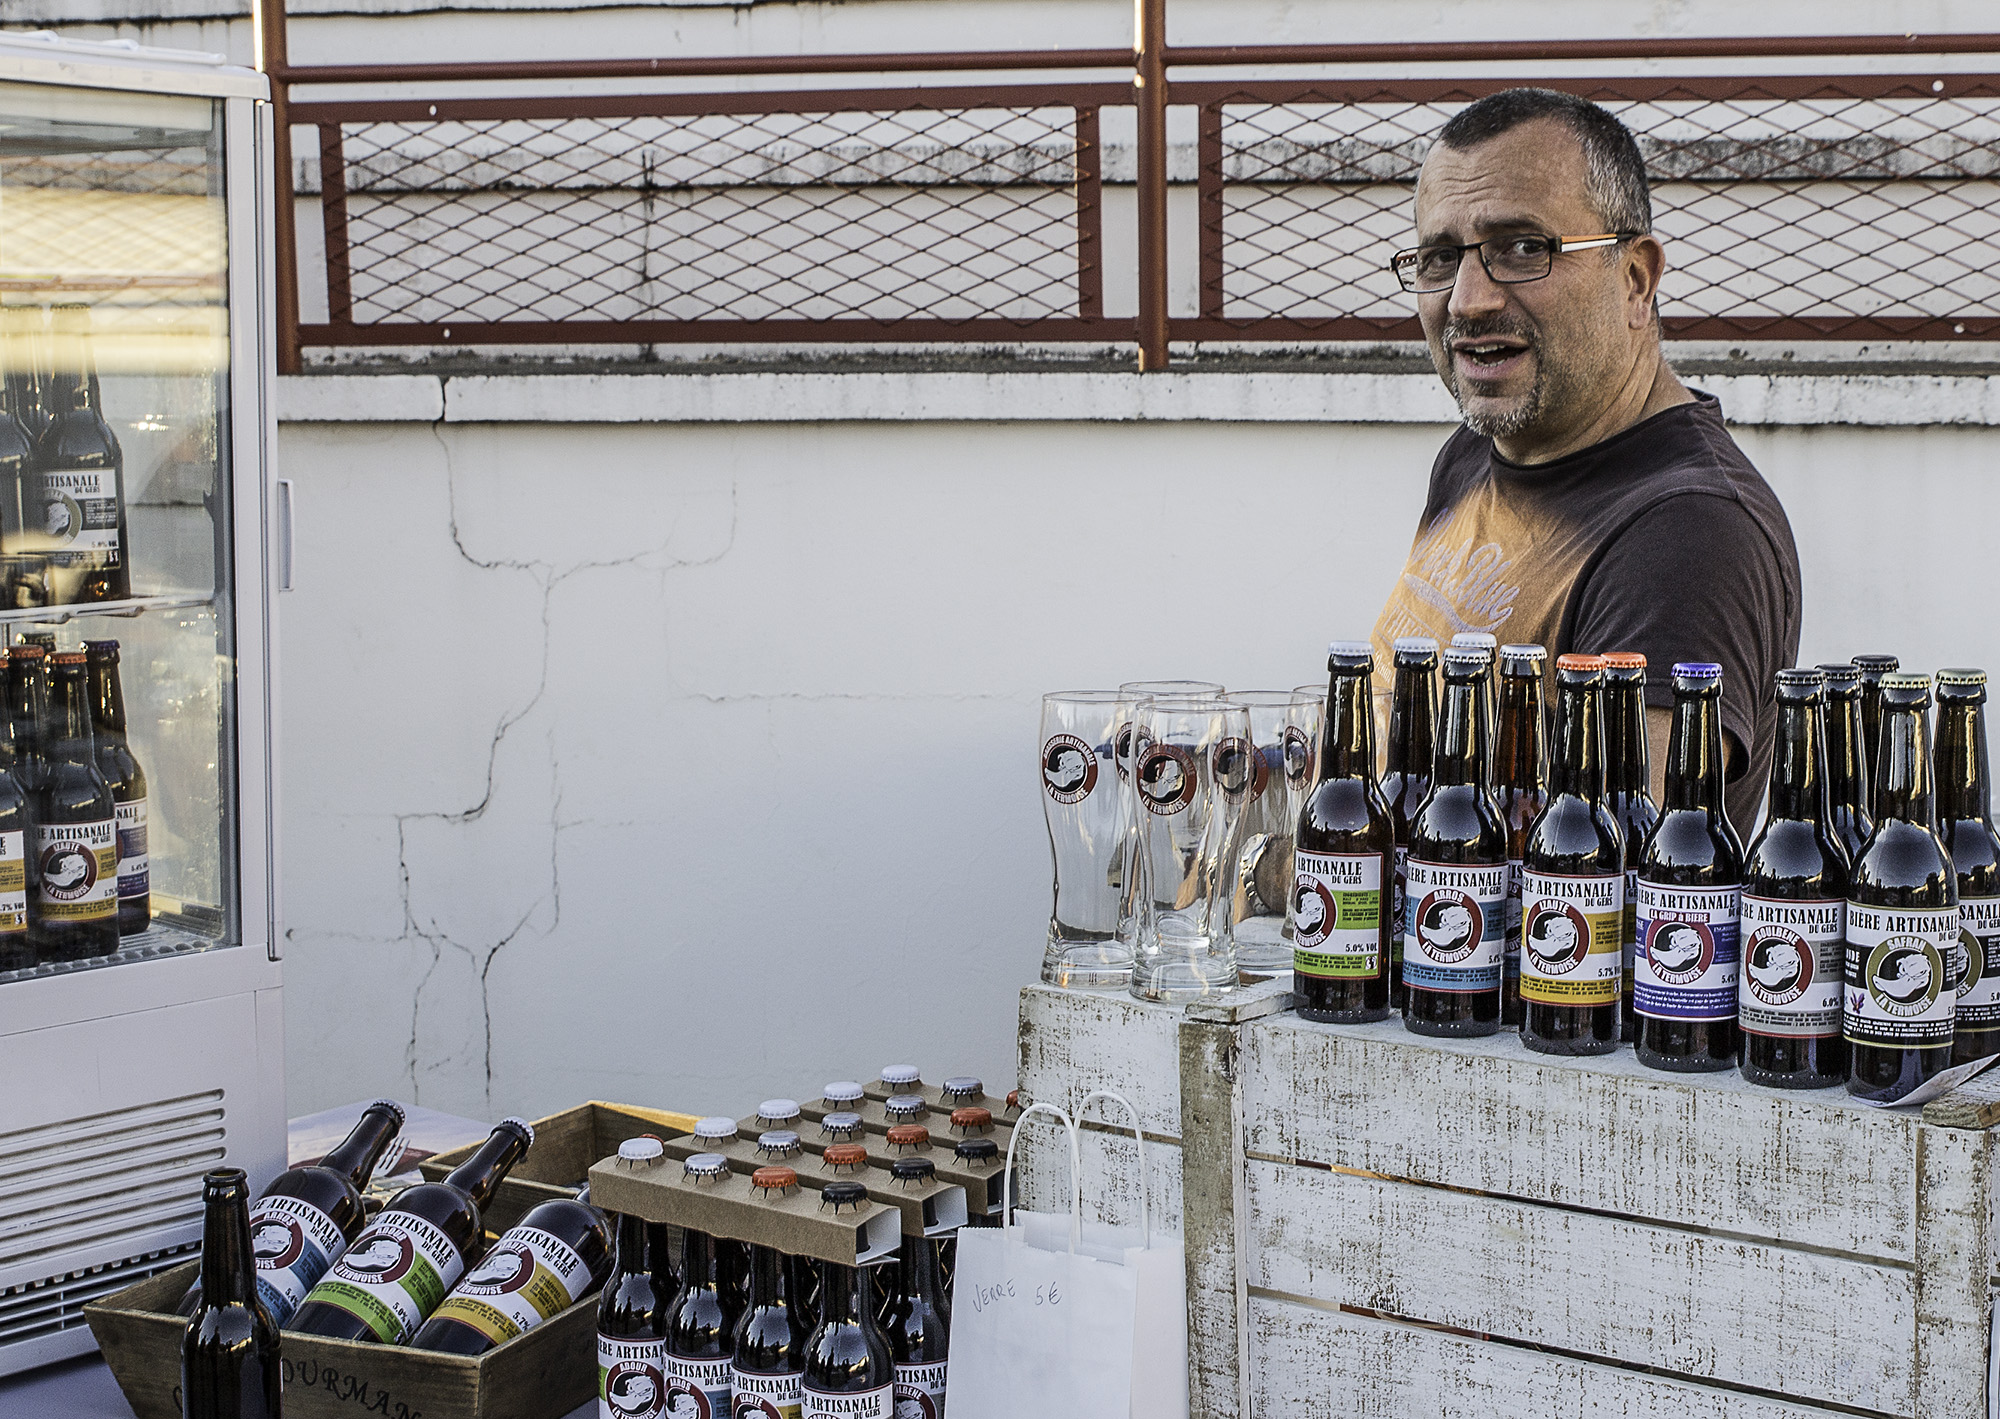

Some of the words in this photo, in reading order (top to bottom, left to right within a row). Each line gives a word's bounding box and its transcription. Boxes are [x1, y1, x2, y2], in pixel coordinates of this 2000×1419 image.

[49, 823, 111, 840] ARTISANALE
[1332, 876, 1341, 884] DU
[1343, 876, 1362, 884] GERS
[1430, 870, 1502, 887] ARTISANALE
[53, 884, 91, 900] TERMOISE
[1433, 889, 1465, 902] ARROS
[1479, 887, 1487, 896] DU
[1536, 880, 1613, 898] ARTISANALE
[1538, 899, 1570, 914] IZAUTE
[1585, 898, 1594, 907] DU
[1596, 897, 1613, 906] GERS
[1659, 893, 1735, 910] ARTISANALE
[1650, 909, 1659, 919] LA
[1659, 910, 1677, 920] GRIP
[1757, 905, 1838, 925] ARTISANALE
[1850, 909, 1881, 931] BIÈRE
[1808, 925, 1819, 934] DU
[1821, 924, 1838, 933] GERS
[1978, 920, 1987, 930] DU
[1754, 926, 1801, 946] BOULBENE
[1886, 936, 1928, 951] SAFRAN
[1345, 944, 1364, 952] 5.0%
[1366, 943, 1378, 952] VOL
[1421, 941, 1432, 954] LA
[1430, 945, 1473, 963] TERMOISE
[1529, 951, 1541, 968] LA
[1538, 957, 1579, 975] TERMOISE
[1598, 966, 1613, 977] 5.7%
[1651, 961, 1661, 977] LA
[1660, 967, 1704, 985] TERMOISE
[1750, 981, 1761, 996] LA
[1758, 986, 1802, 1005] TERMOISE
[1822, 997, 1839, 1008] 6.0%
[1875, 994, 1887, 1010] LA
[1885, 995, 1932, 1017] TERMOISE
[263, 1211, 296, 1227] ARROS
[266, 1198, 342, 1248] ARTISANALE
[375, 1226, 408, 1242] ADOUR
[381, 1213, 455, 1260] ARTISANALE
[421, 1240, 432, 1252] DU
[431, 1249, 450, 1270] GERS
[542, 1250, 555, 1262] DU
[972, 1279, 1016, 1312] VERRE
[392, 1301, 408, 1323] 5.0%
[619, 1362, 648, 1373] ADOUR
[667, 1359, 732, 1379] ARTISANALE
[704, 1377, 715, 1386] DU
[777, 1392, 787, 1400] DU
[810, 1394, 881, 1413] ARTISANALE
[865, 1409, 881, 1418] GERS
